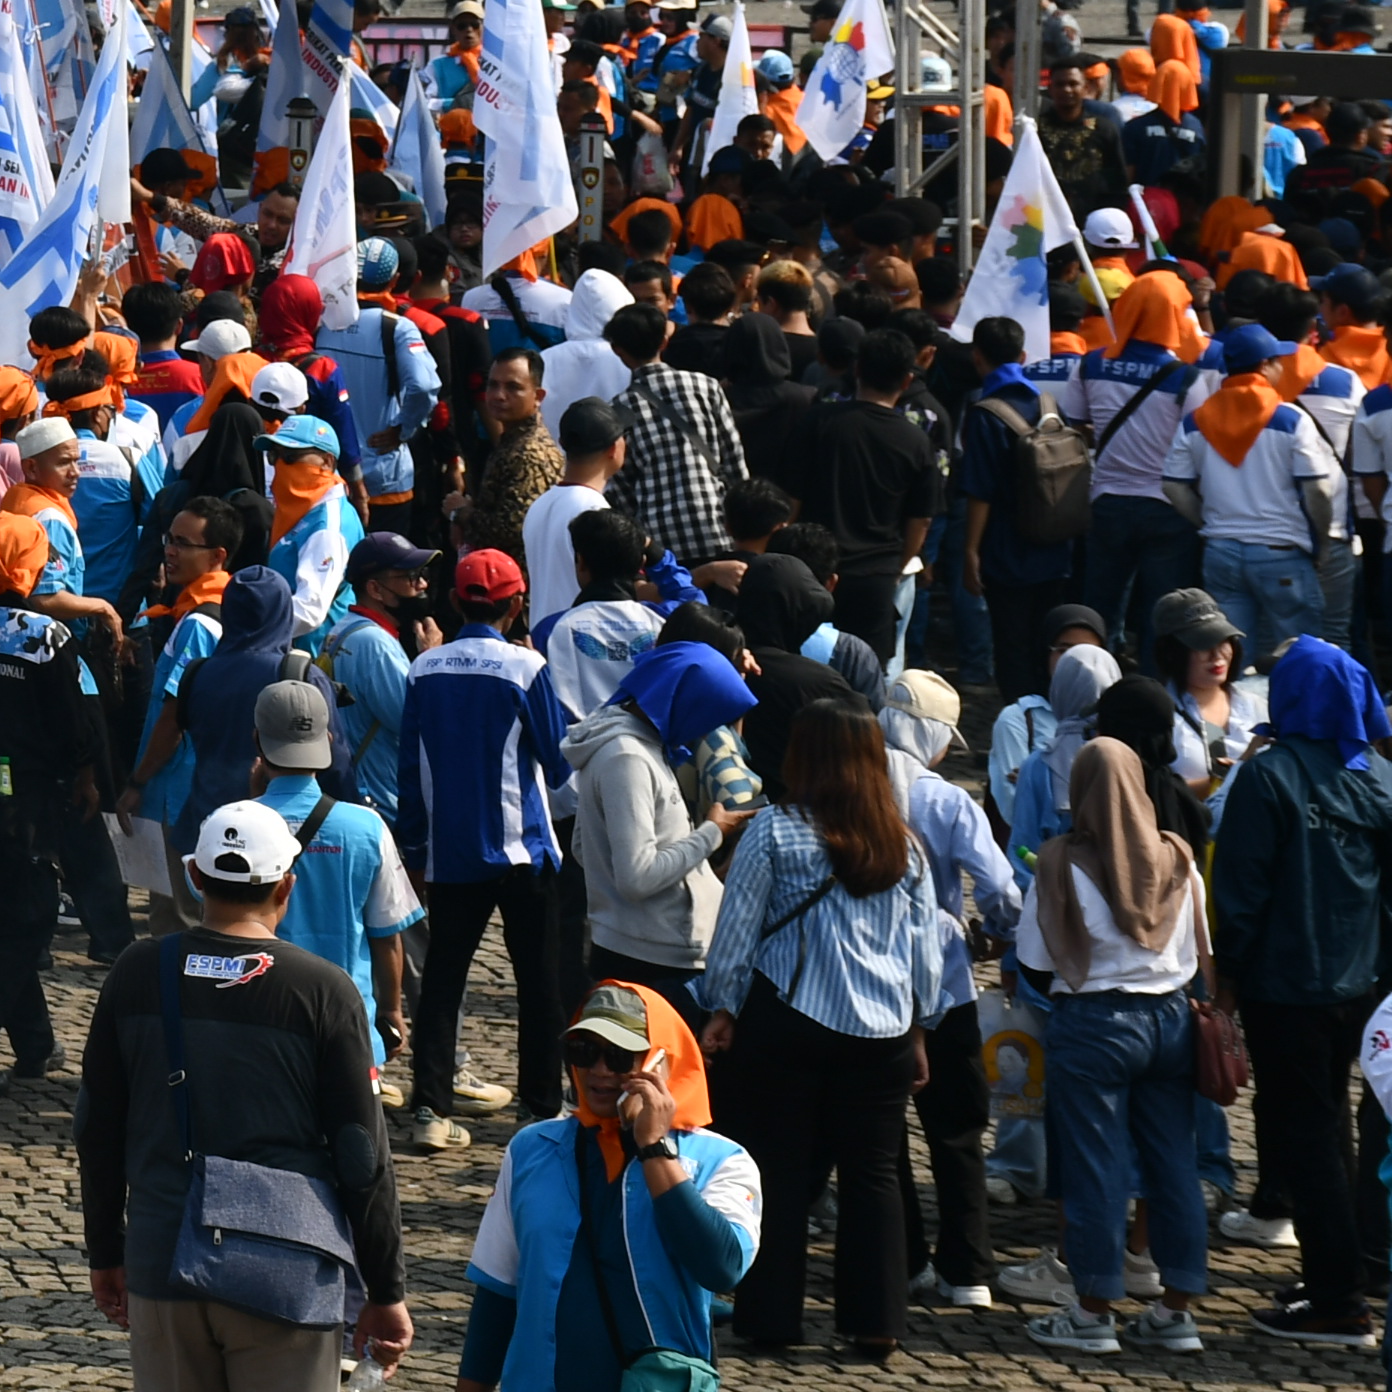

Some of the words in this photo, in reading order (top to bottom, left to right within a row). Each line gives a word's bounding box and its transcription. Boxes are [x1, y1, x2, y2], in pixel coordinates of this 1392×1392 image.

[426, 657, 443, 668] FSP
[445, 656, 477, 669] RTMM
[480, 658, 503, 670] SPSI
